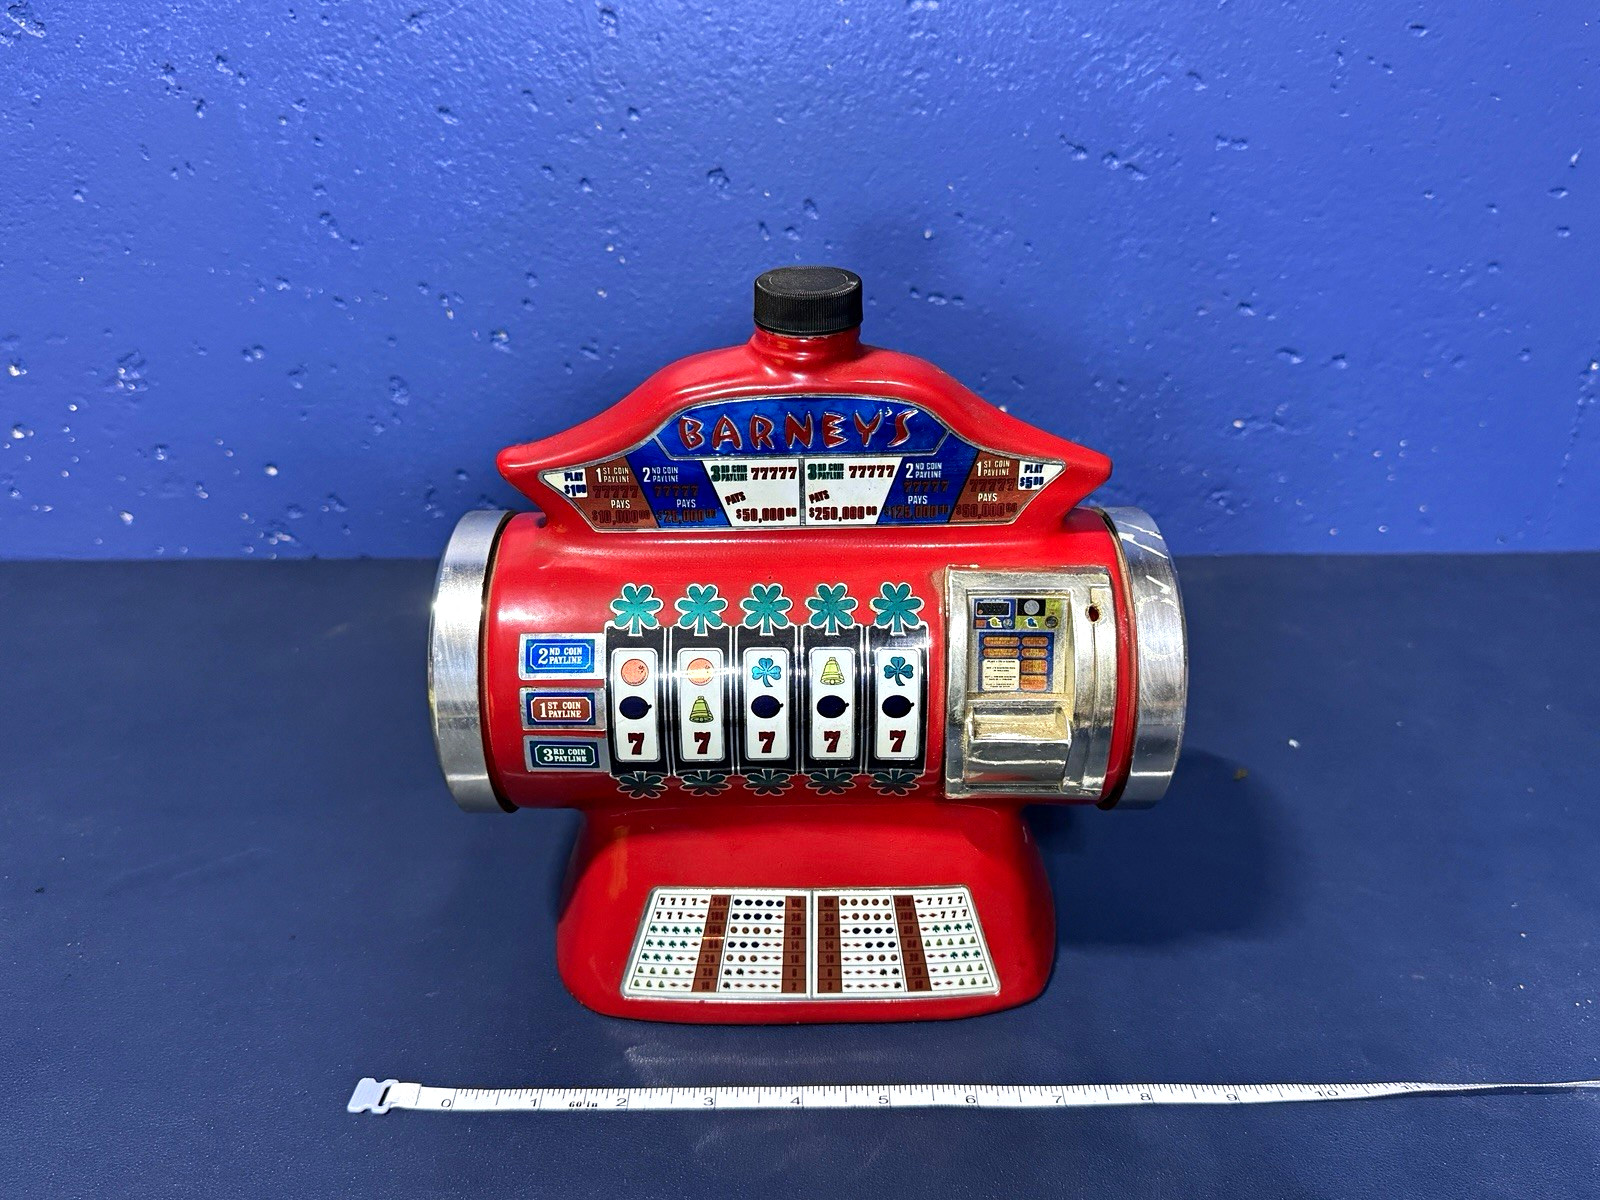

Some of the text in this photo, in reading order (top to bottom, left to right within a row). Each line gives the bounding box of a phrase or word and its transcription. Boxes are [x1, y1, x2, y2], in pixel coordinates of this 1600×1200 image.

[678, 407, 919, 450] BARNEY'S
[994, 460, 1010, 468] COIN
[1024, 464, 1044, 473] PLAY
[613, 467, 629, 475] COIN
[662, 466, 679, 474] COIN
[731, 464, 748, 472] COIN
[750, 466, 797, 480] 77777
[828, 463, 844, 471] COIN
[848, 464, 896, 478] 77777
[564, 472, 584, 482] PLAY
[725, 491, 747, 506] PAYS
[808, 490, 830, 504] PAYS
[907, 495, 928, 505] PAYS
[977, 492, 998, 502] PAYS
[610, 499, 631, 509] PAYS
[676, 499, 697, 508] PAYS
[563, 647, 583, 655] COIN
[549, 655, 583, 664] PAYLINE
[562, 701, 581, 710] COIN
[548, 709, 582, 718] PAYLINE
[627, 730, 907, 756] 7 7 7 7 7
[567, 748, 586, 756] COIN
[553, 755, 587, 763] PAYLINE
[659, 897, 698, 906] 7 7 7 7
[926, 896, 964, 906] 7 7 7 7
[655, 911, 684, 920] 7 7 7
[940, 909, 968, 919] 7 7 7
[440, 1098, 452, 1108] 0
[530, 1098, 538, 1108] 1
[615, 1097, 627, 1107] 2
[703, 1096, 714, 1107] 3
[790, 1096, 801, 1105] 4
[878, 1095, 889, 1105] 5
[965, 1095, 977, 1104] 6
[1051, 1095, 1062, 1104] 7
[1140, 1091, 1151, 1101] 8
[1226, 1092, 1237, 1101] 9
[1314, 1089, 1339, 1097] 10
